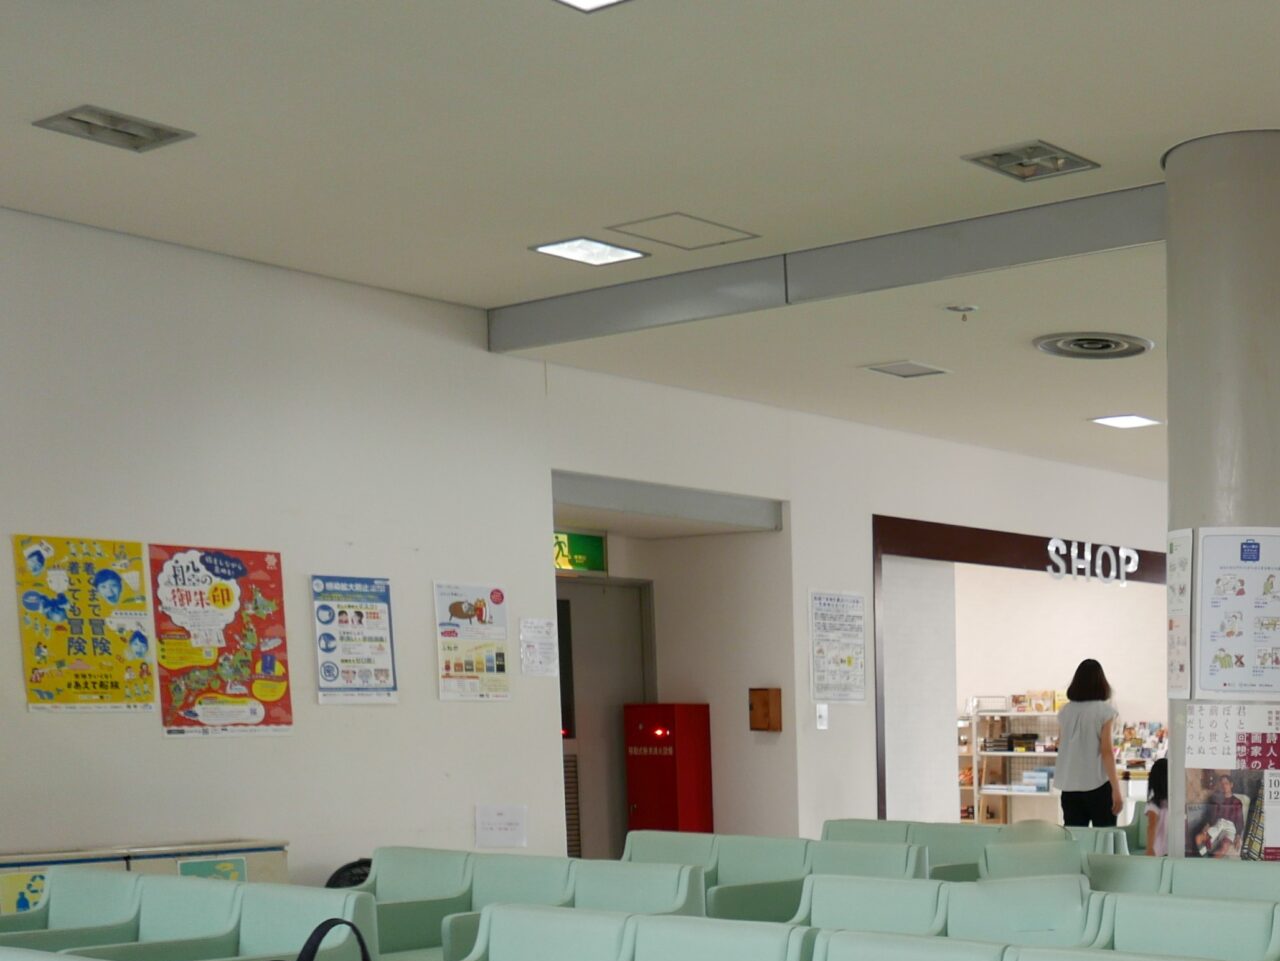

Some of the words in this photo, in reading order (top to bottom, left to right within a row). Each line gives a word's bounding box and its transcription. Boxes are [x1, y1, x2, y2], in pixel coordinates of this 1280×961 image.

[1046, 537, 1139, 587] SHOP
[67, 561, 87, 656] 着いても冒険
[1269, 779, 1280, 788] 10
[1269, 791, 1280, 800] 12
